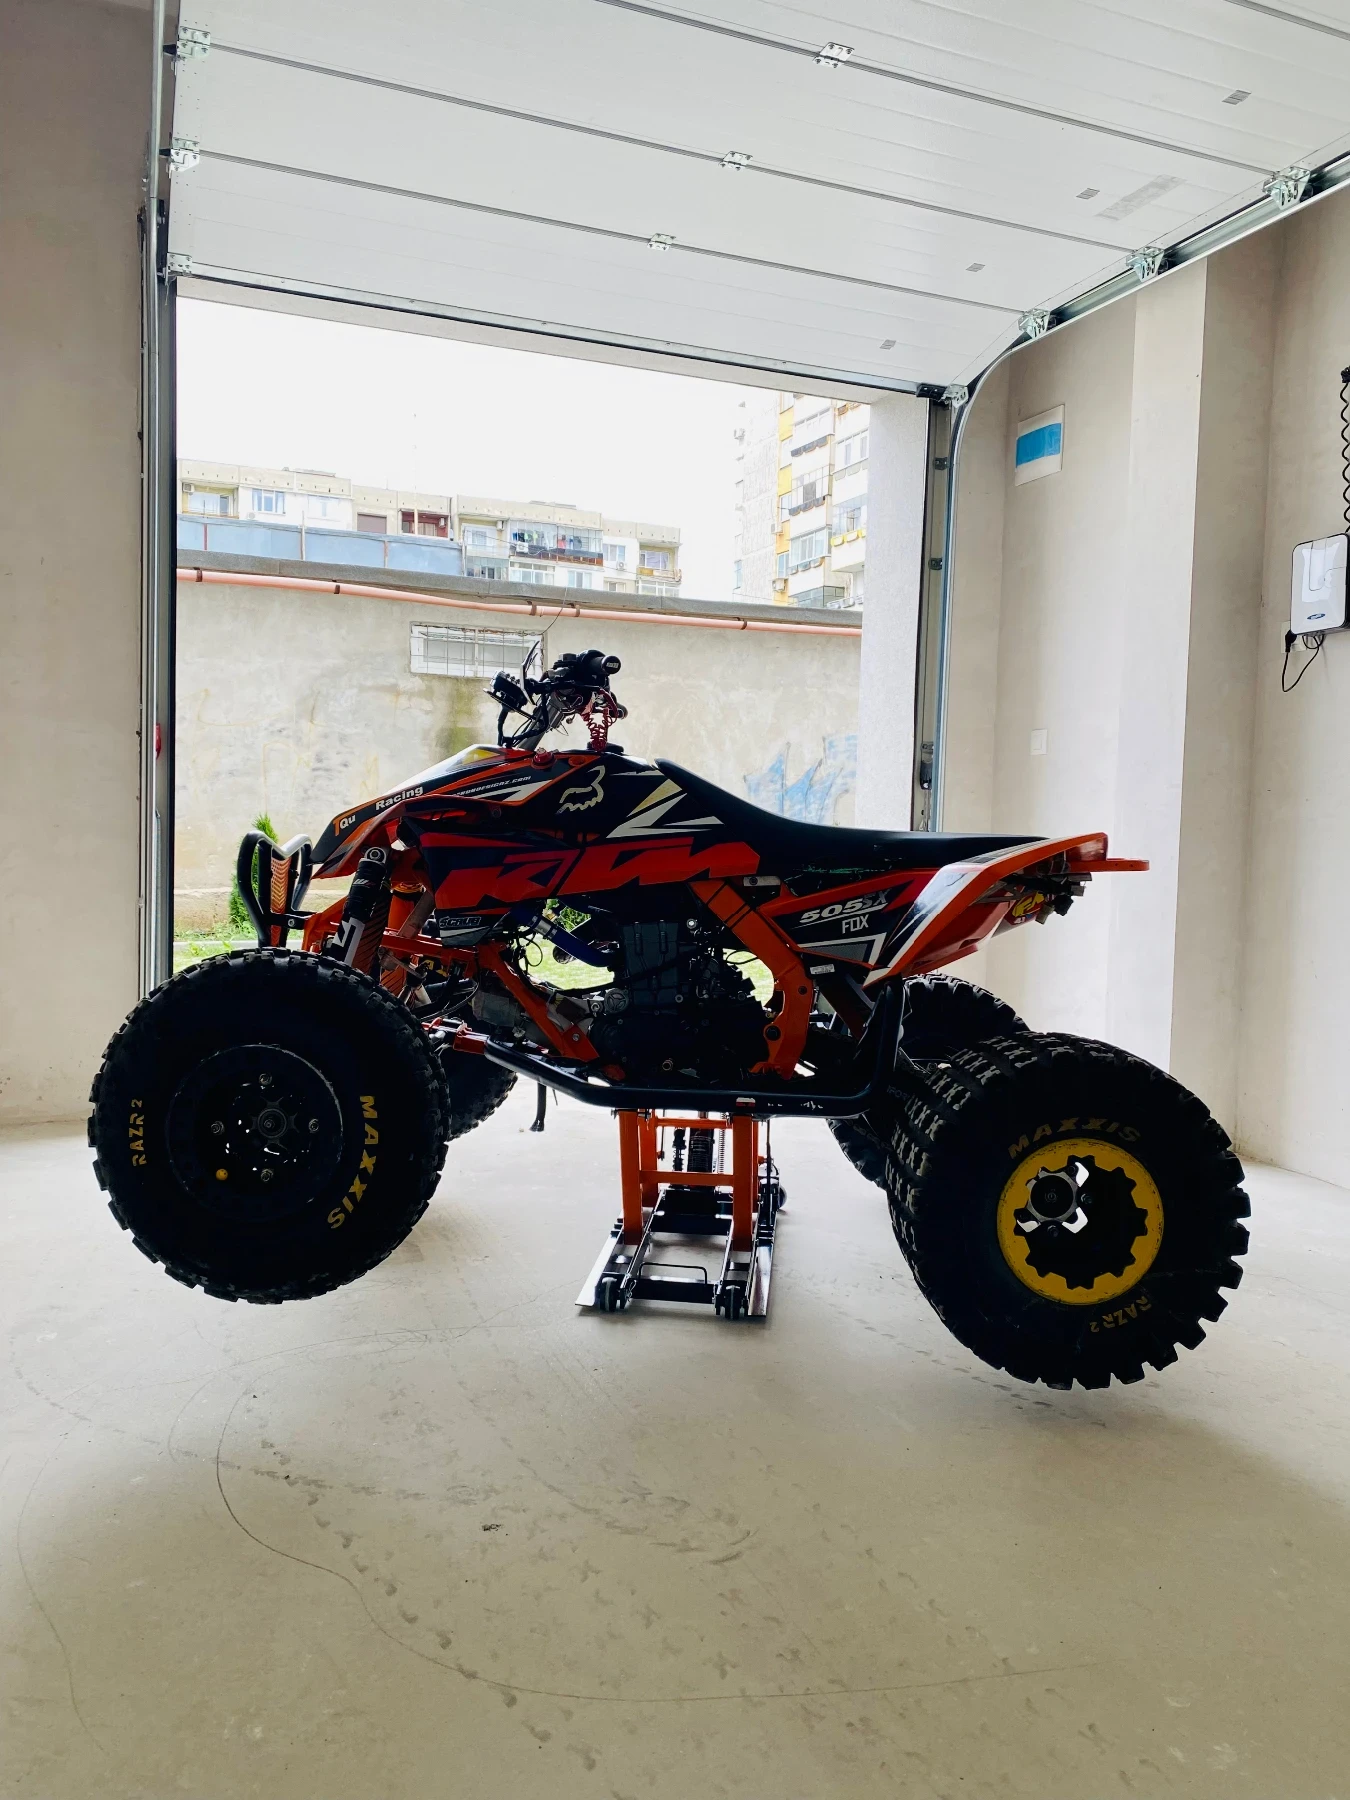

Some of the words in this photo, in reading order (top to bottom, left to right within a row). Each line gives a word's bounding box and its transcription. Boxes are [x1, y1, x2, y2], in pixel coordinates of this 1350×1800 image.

[375, 786, 424, 811] Racing
[434, 837, 760, 909] KTM
[842, 914, 869, 934] FOX
[1008, 1117, 1140, 1159] MAXXIS
[327, 1095, 380, 1230] MAXXIS
